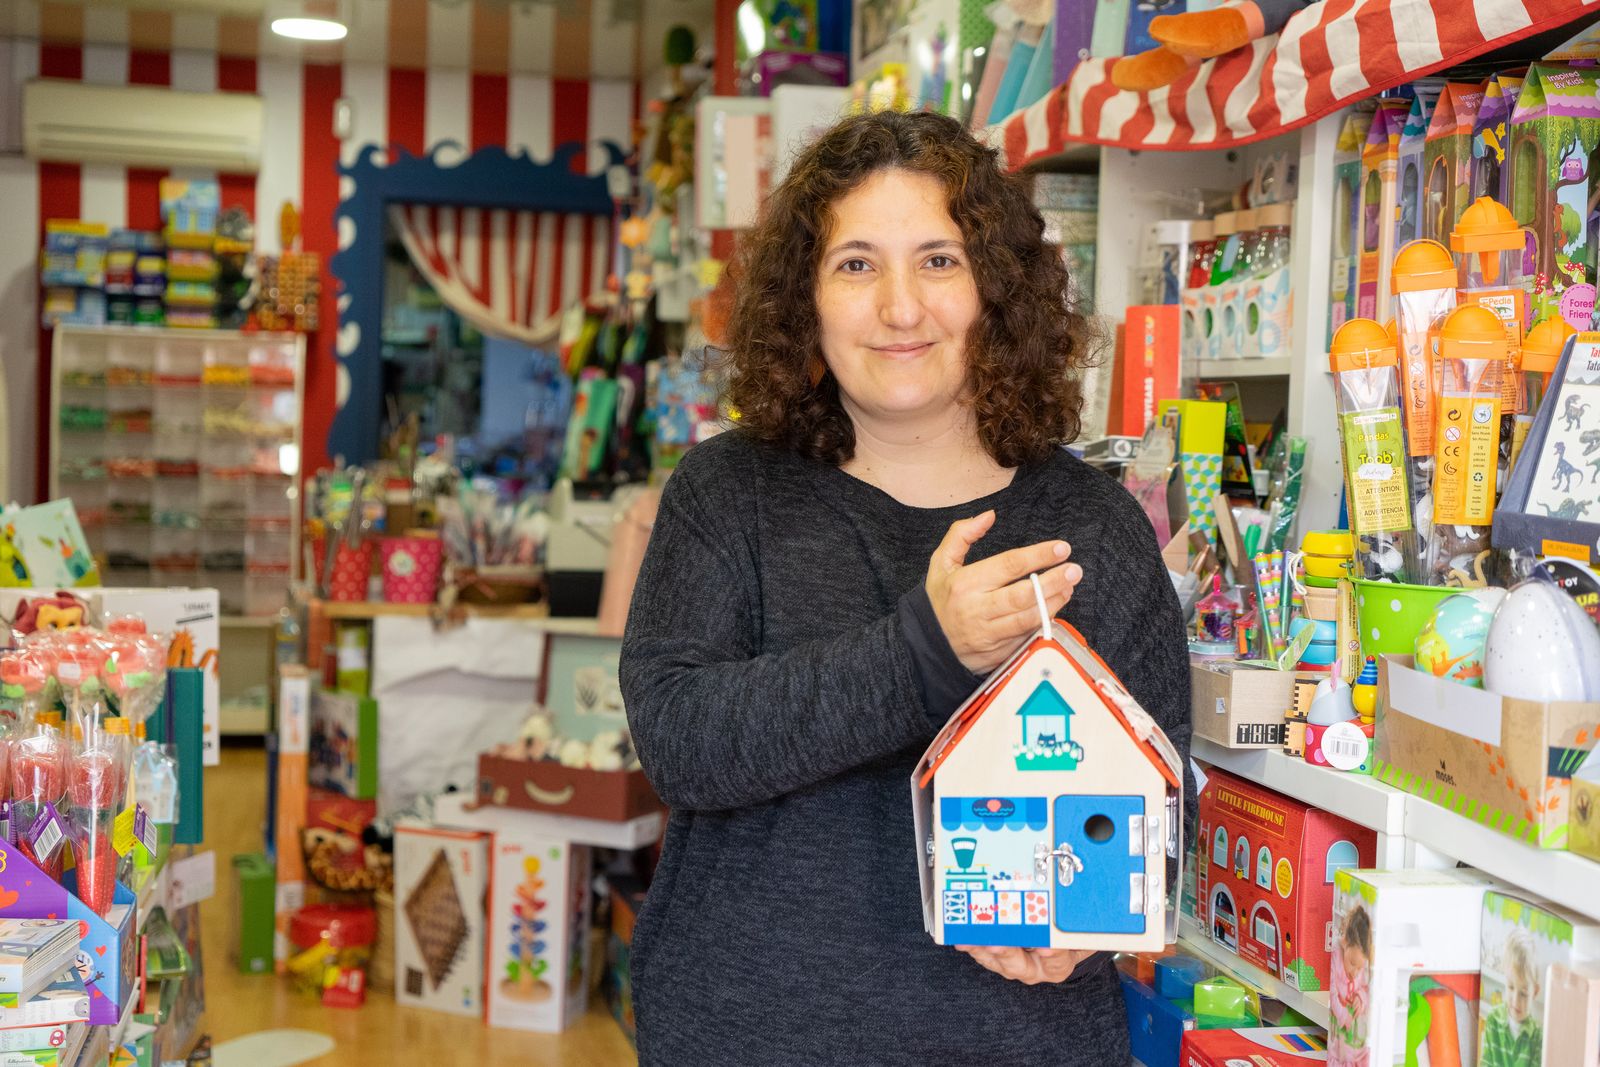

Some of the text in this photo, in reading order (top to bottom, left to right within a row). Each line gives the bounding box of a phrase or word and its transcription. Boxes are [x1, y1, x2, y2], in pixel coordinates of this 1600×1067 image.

[1546, 70, 1580, 82] Inspired
[1553, 78, 1584, 89] By Kids
[1358, 432, 1390, 443] Pandas
[1444, 446, 1461, 457] CE
[1358, 451, 1393, 465] Toob
[1365, 486, 1402, 495] ATTENTION:
[1239, 724, 1277, 743] THE
[1217, 789, 1243, 809] LITTLE
[1242, 800, 1285, 827] FIREHOUSE
